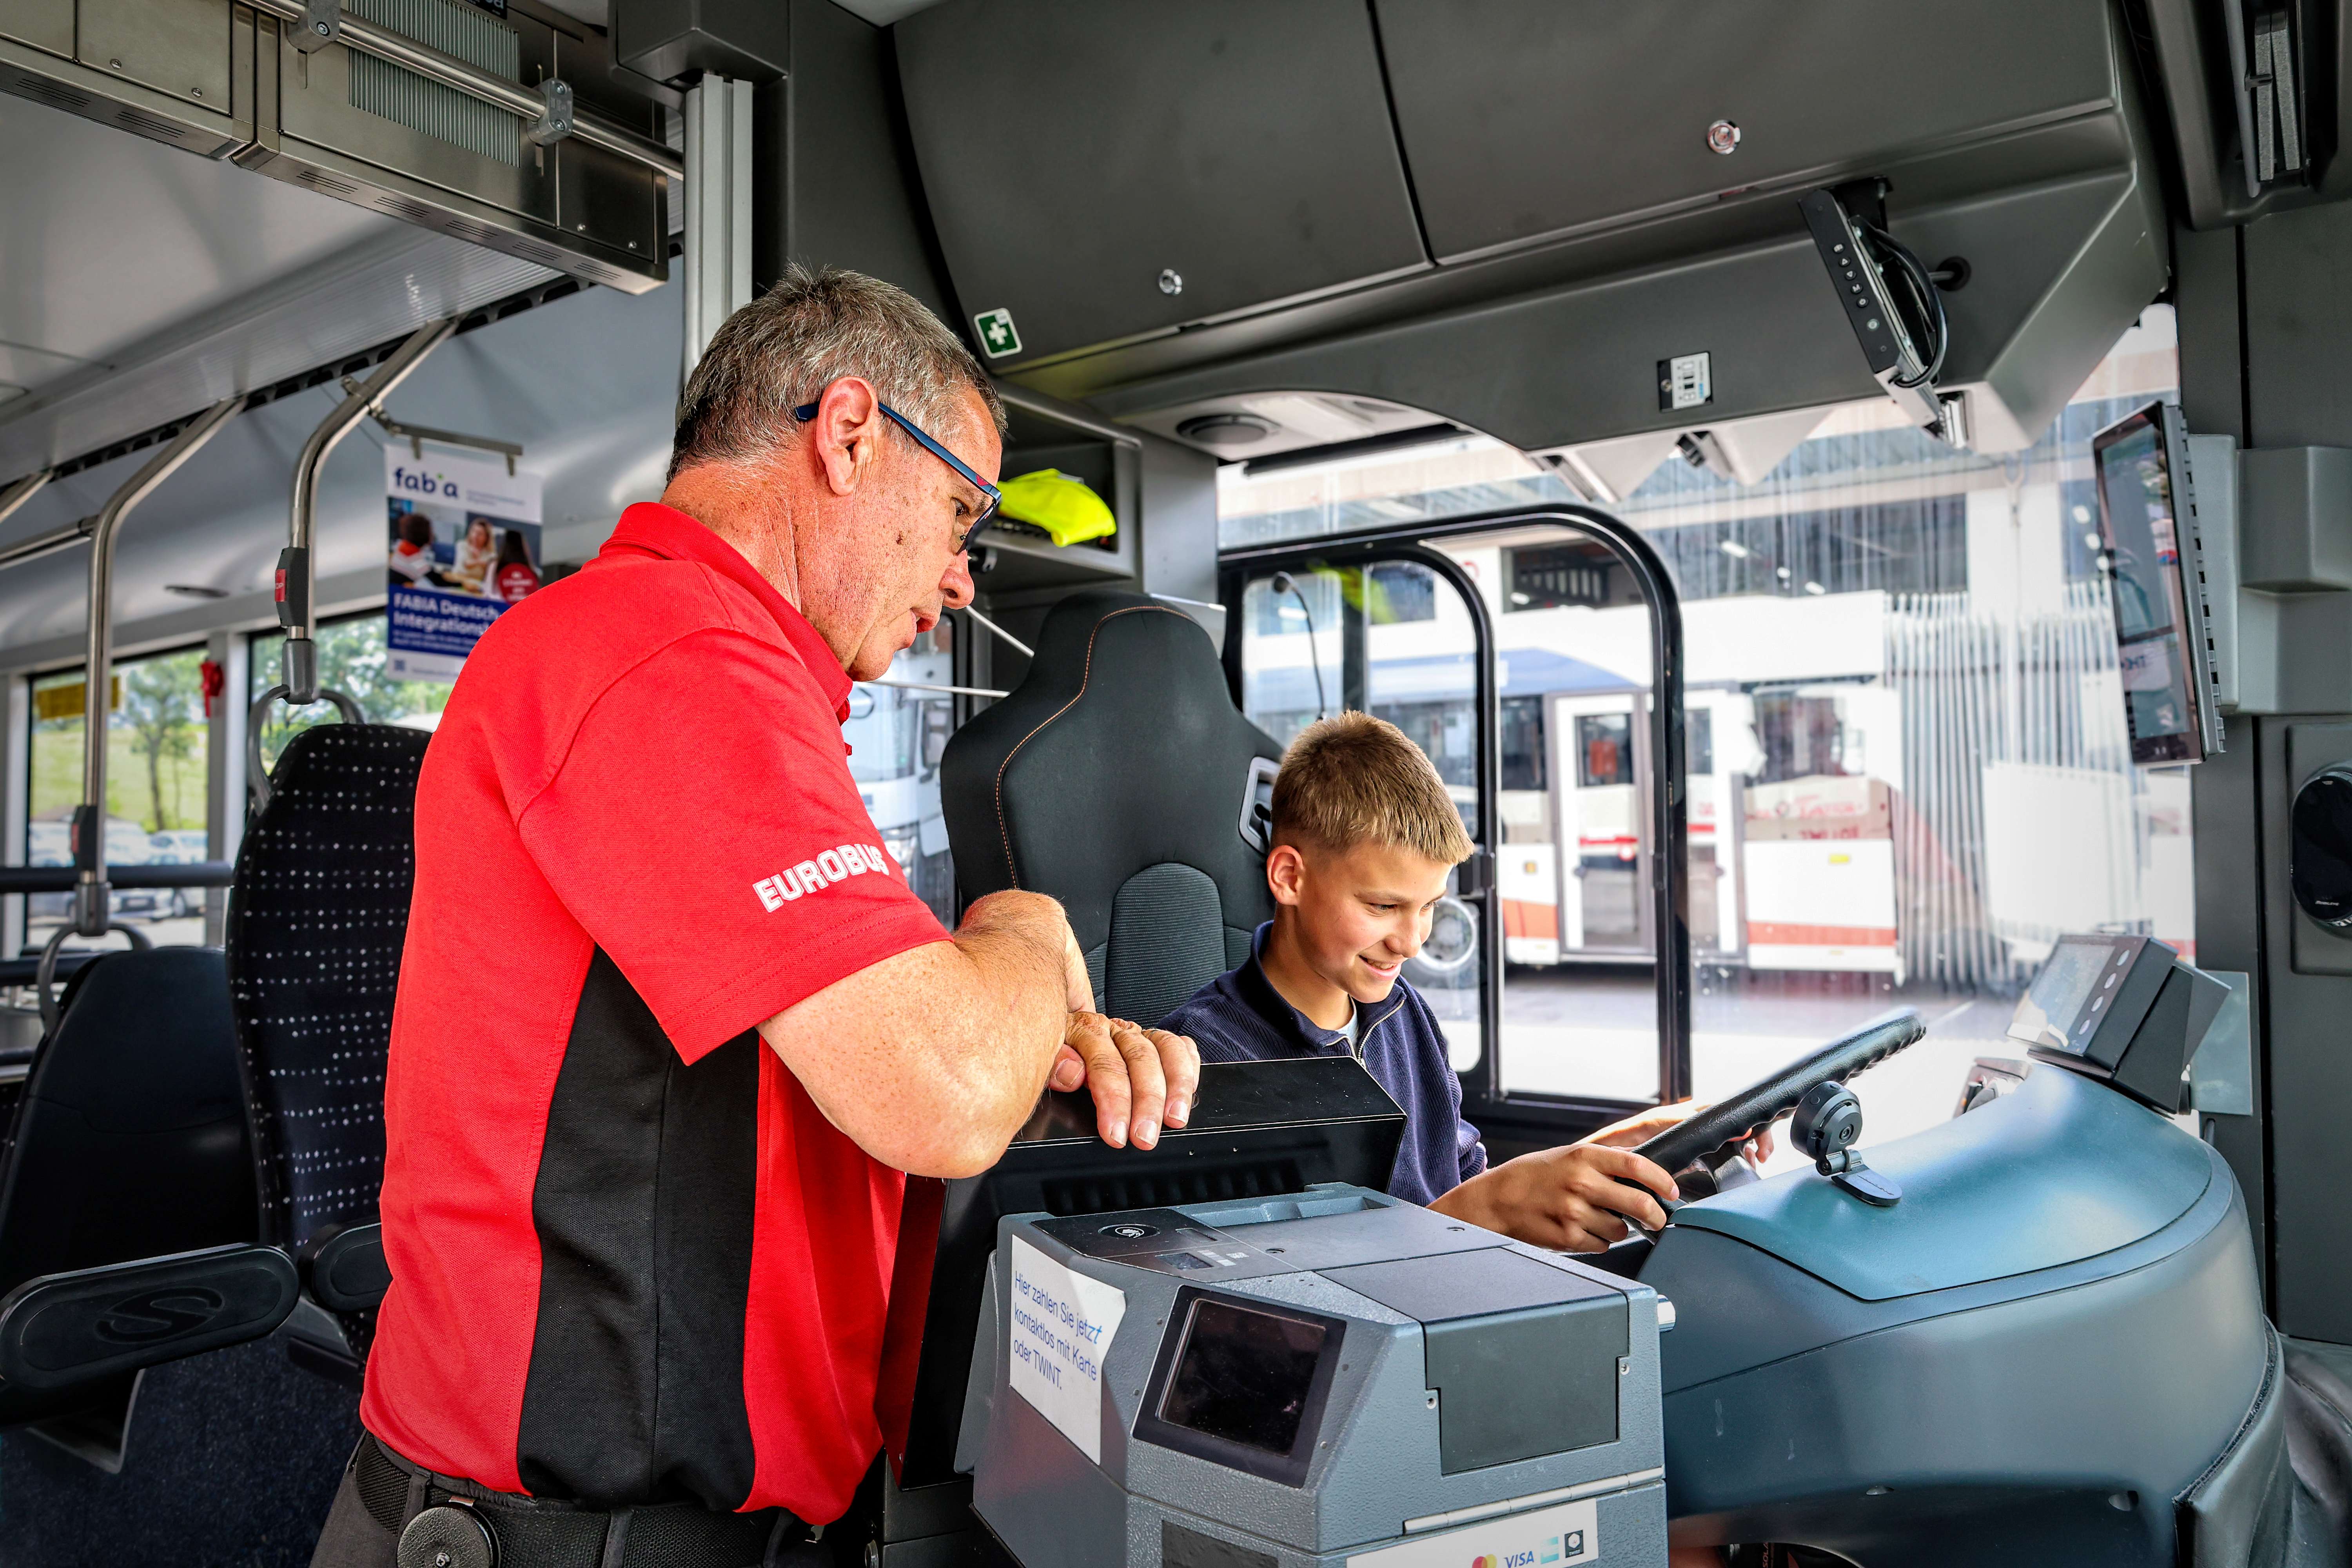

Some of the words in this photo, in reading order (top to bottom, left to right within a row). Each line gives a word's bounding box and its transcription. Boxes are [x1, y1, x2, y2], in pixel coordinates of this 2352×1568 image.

[394, 592, 439, 613] FABIA
[752, 844, 889, 913] EUROBUS
[1015, 1270, 1031, 1297] Hier
[1032, 1287, 1058, 1318] zahlen
[1060, 1302, 1074, 1328] Sie
[1076, 1312, 1102, 1344] jetzt
[1014, 1302, 1054, 1349] kontaktlos
[1057, 1338, 1070, 1361] mit
[1073, 1345, 1097, 1381] Karte
[1014, 1339, 1032, 1364] oder
[1033, 1349, 1062, 1390] TWINT.
[1504, 1550, 1534, 1568] VISA
